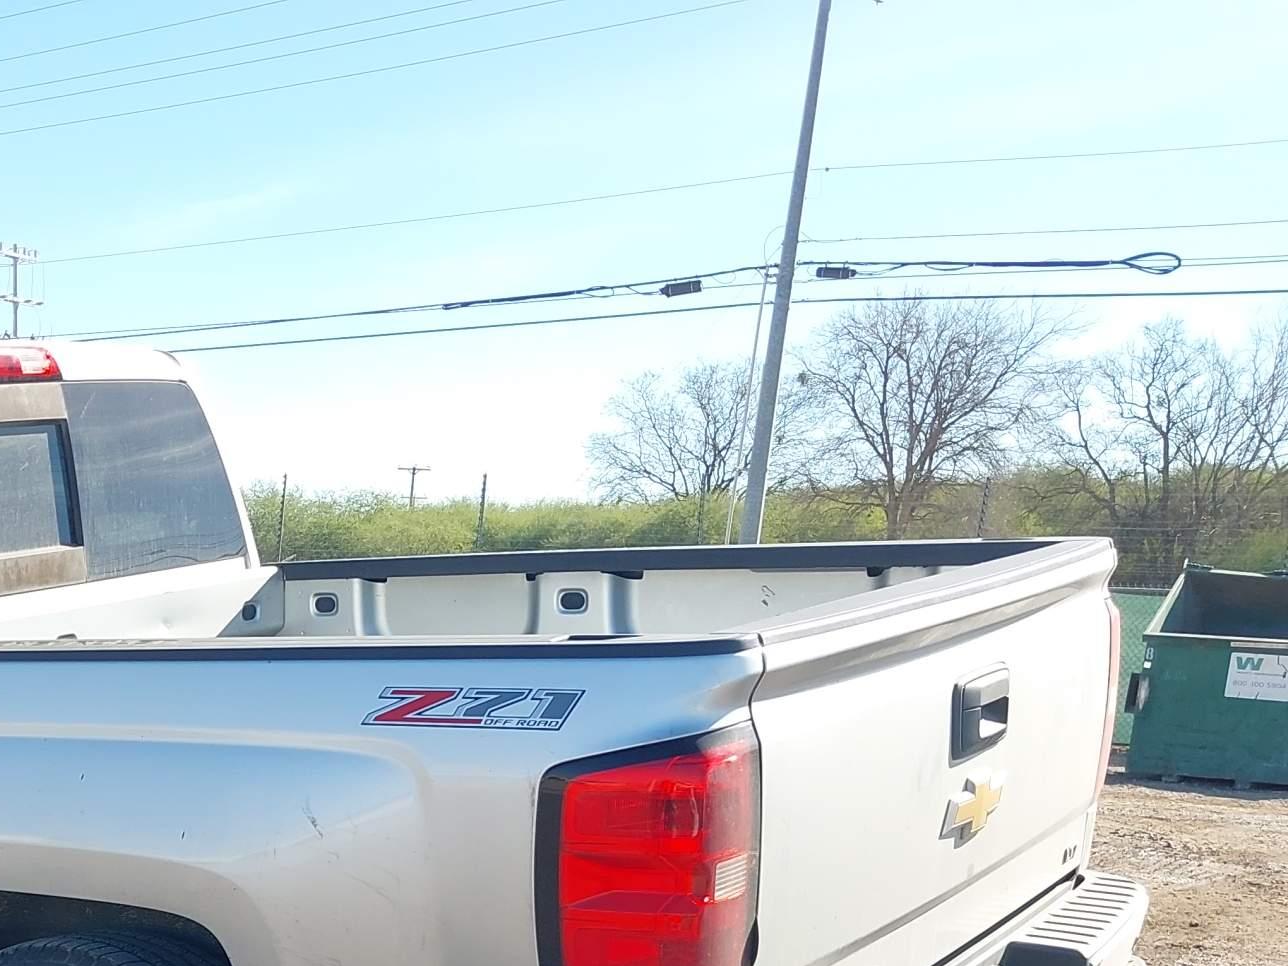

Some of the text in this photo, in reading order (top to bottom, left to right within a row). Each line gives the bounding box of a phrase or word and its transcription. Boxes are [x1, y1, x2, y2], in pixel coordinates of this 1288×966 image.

[361, 686, 585, 730] Z71
[484, 718, 560, 728] OFF ROAD
